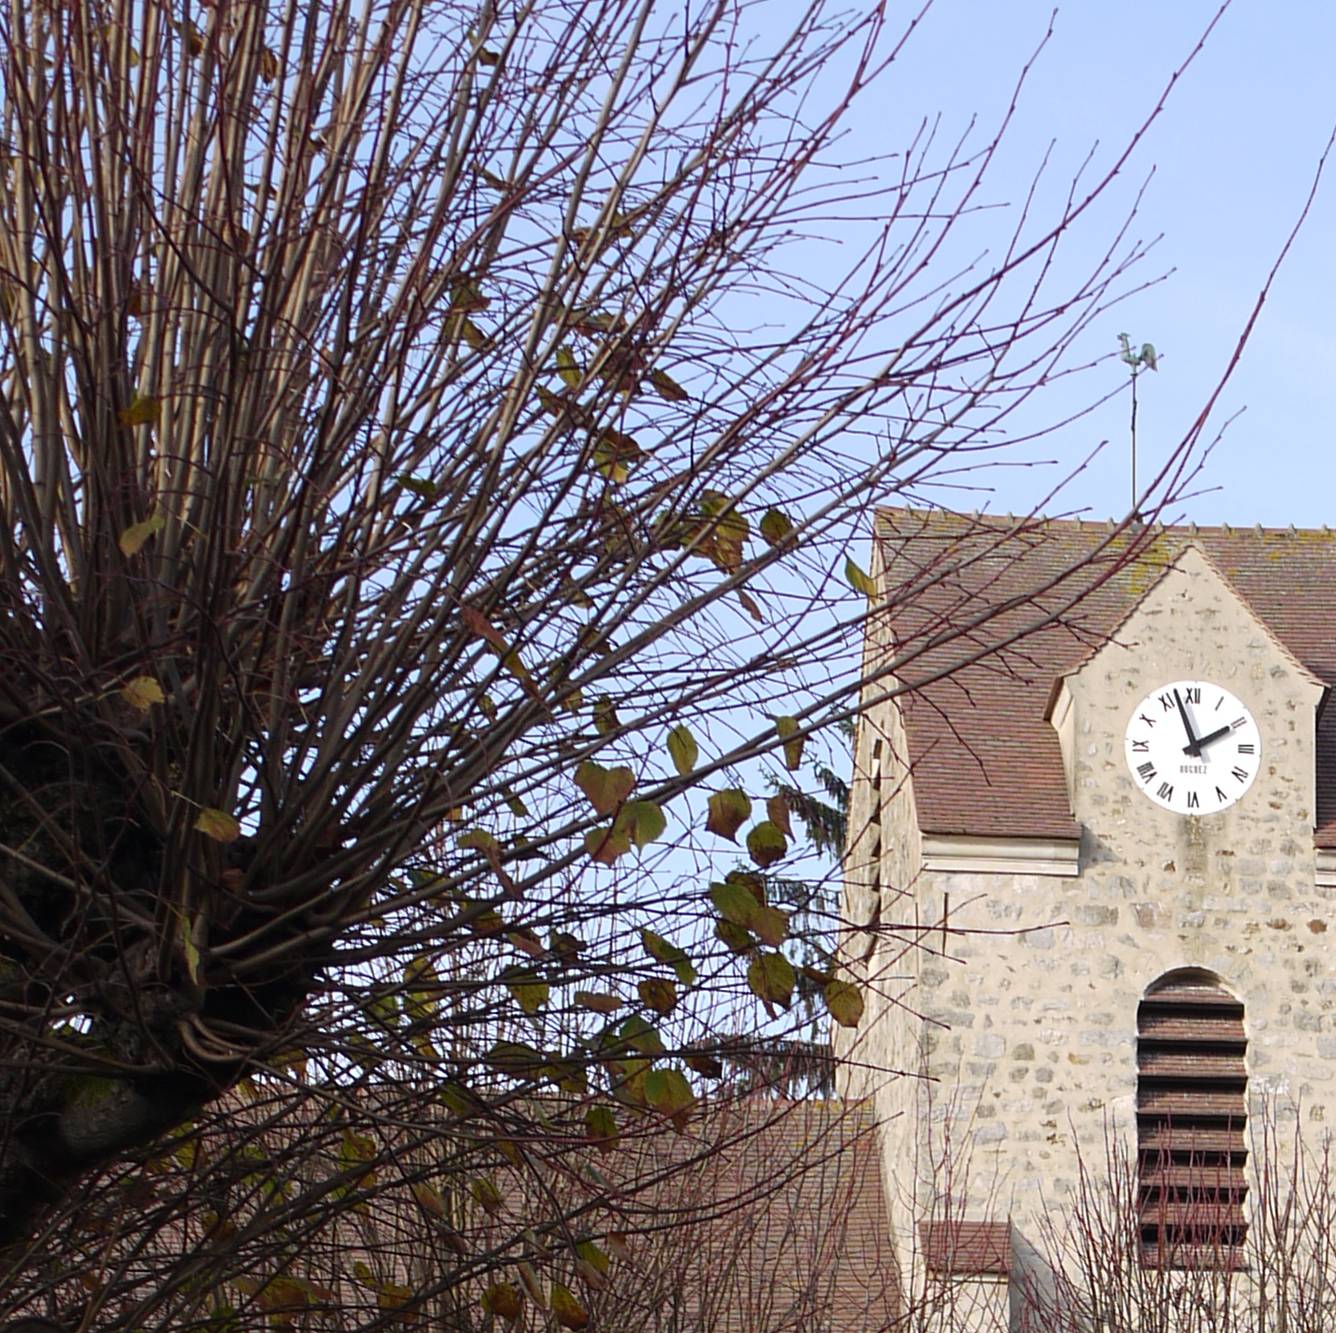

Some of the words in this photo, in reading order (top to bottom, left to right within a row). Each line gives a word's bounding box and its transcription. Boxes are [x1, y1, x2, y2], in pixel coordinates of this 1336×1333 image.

[1158, 692, 1175, 712] XI
[1185, 687, 1201, 704] XII
[1215, 696, 1224, 711] I
[1139, 713, 1157, 728] X
[1230, 716, 1247, 729] II
[1132, 739, 1149, 752] IX
[1237, 744, 1255, 755] III
[1136, 761, 1158, 784] VIII
[1231, 765, 1249, 784] IV
[1156, 781, 1174, 803] VII
[1187, 791, 1200, 808] VI
[1215, 785, 1228, 803] V
